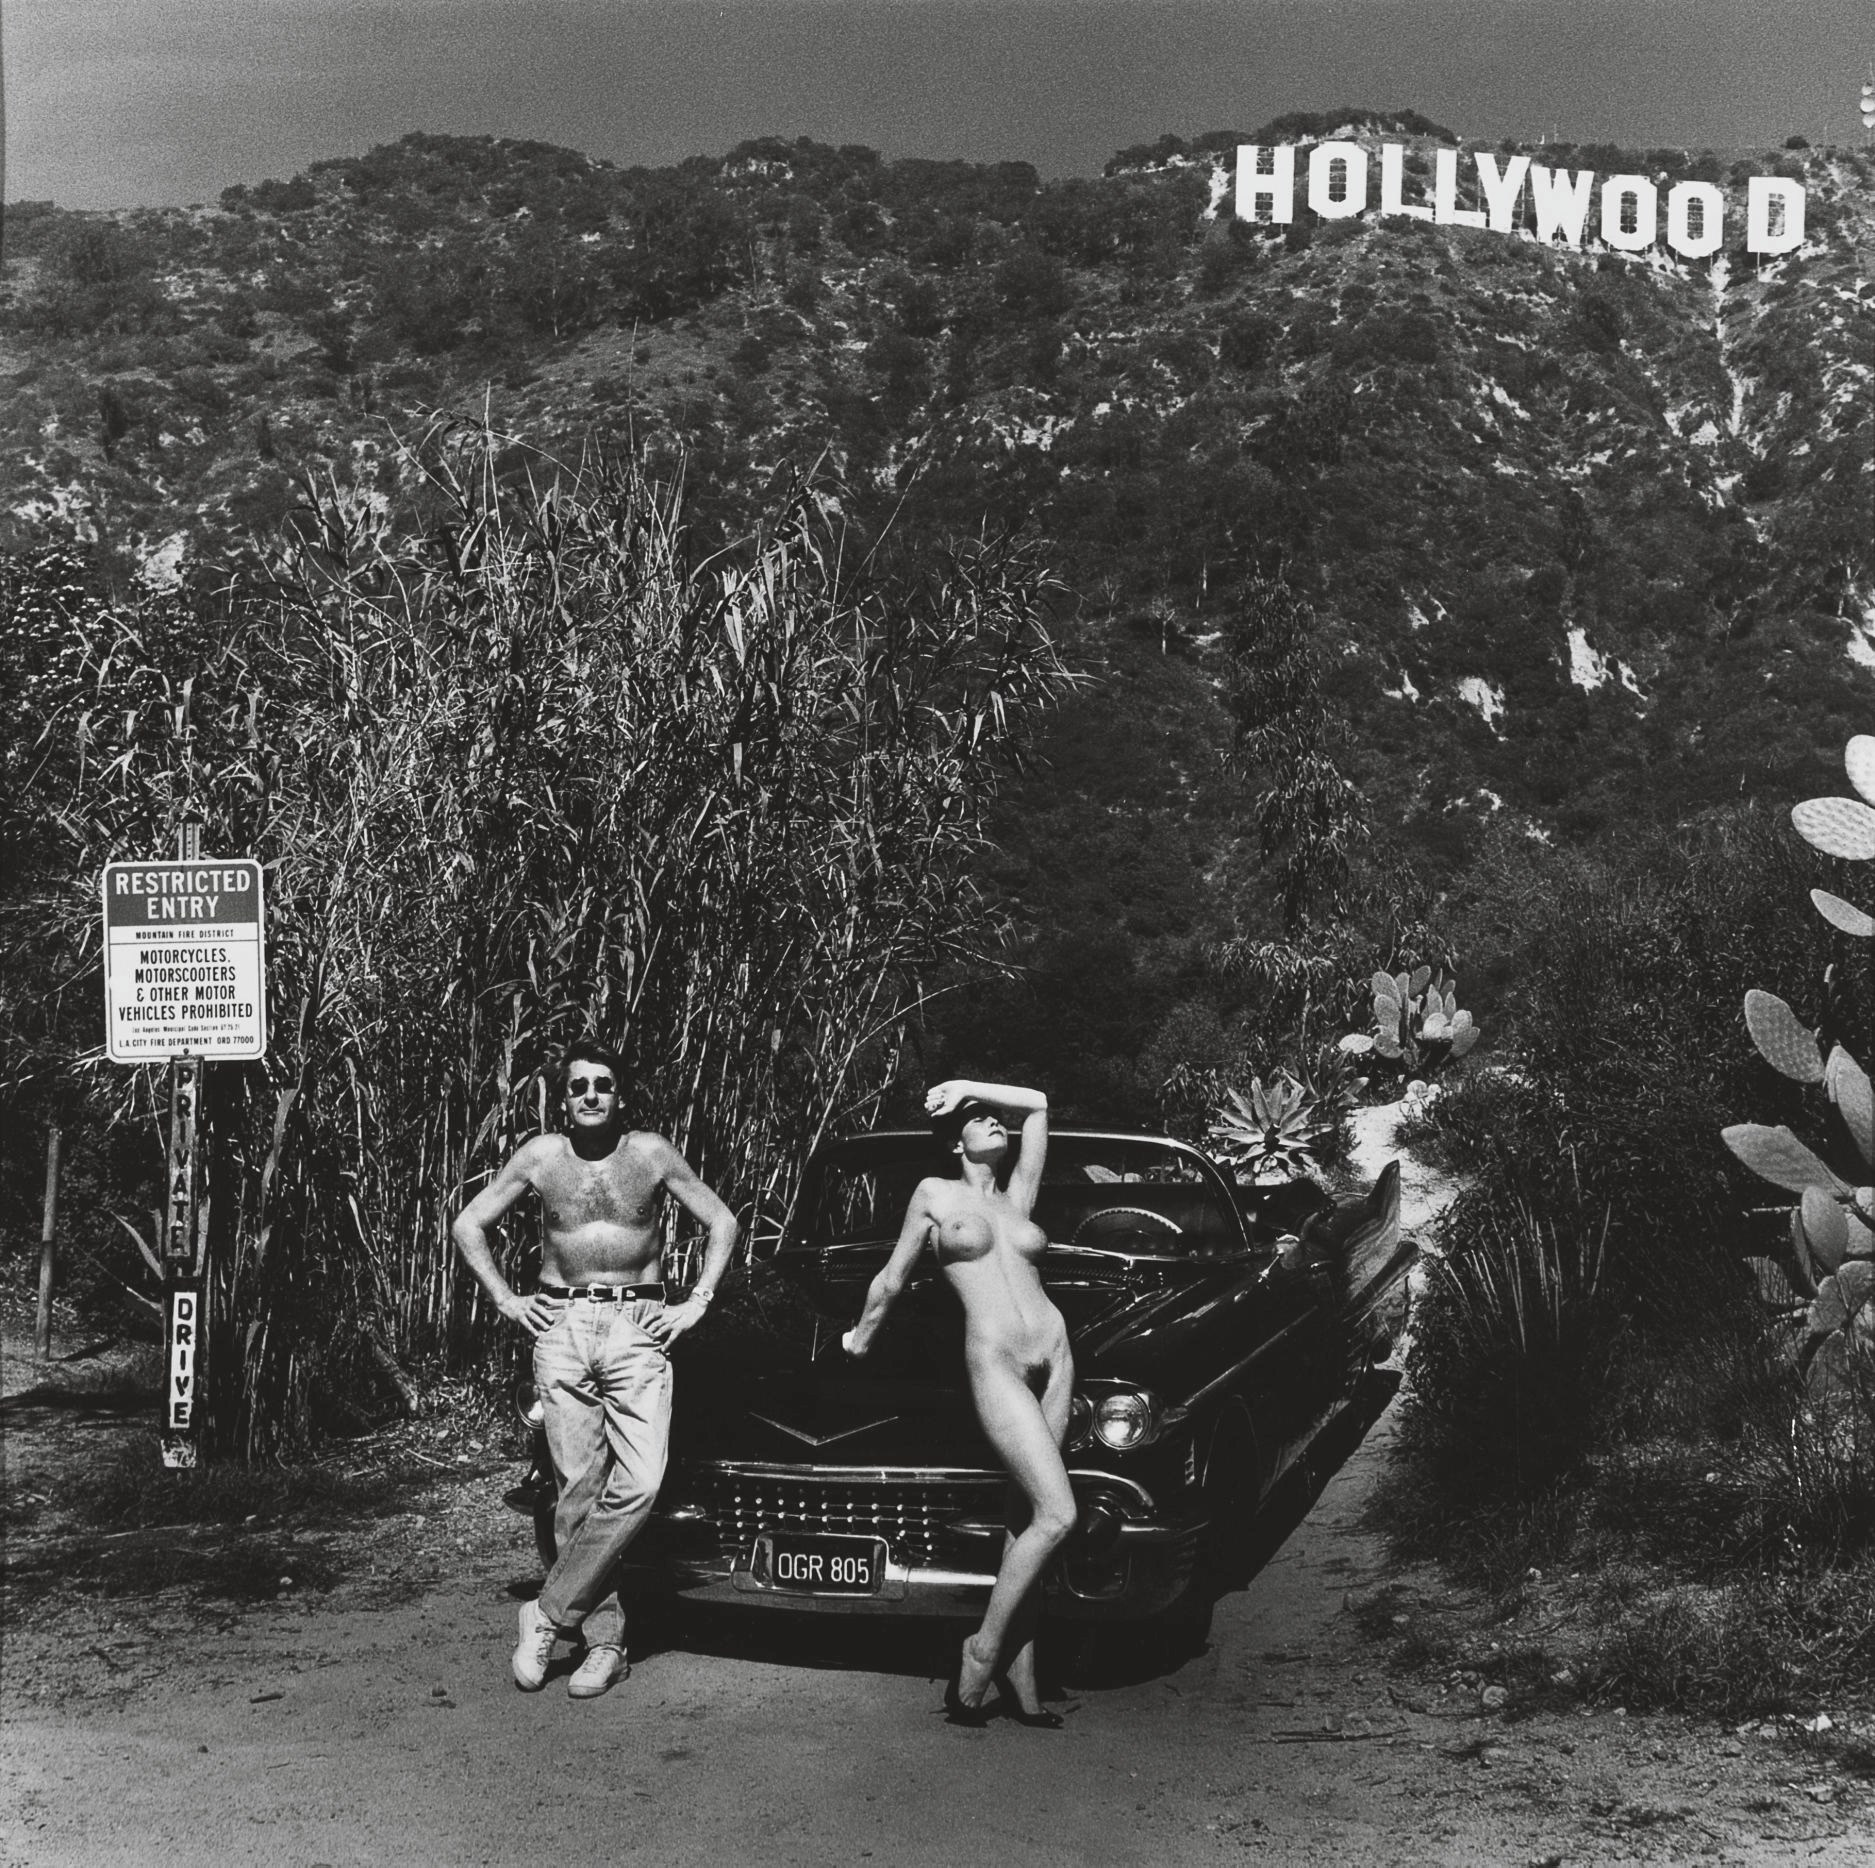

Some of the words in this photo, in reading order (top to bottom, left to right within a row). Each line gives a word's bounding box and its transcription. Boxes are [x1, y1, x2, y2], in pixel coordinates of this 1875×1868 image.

[1236, 142, 1805, 258] HOLLYWOOD
[115, 870, 250, 895] RESTRICTED
[147, 895, 219, 919] ENTRY
[135, 931, 174, 940] MOUNTAIN
[178, 931, 195, 939] FIRE
[200, 929, 234, 938] DISTRICT
[135, 966, 236, 983] MOTORSCOOTERS
[136, 988, 144, 1002] &
[150, 987, 189, 1002] OTHER
[195, 985, 236, 1000] MOTOR
[119, 1005, 176, 1021] VEHICLES
[181, 1003, 253, 1019] PROHIBITED
[132, 1039, 147, 1047] CITY
[150, 1038, 165, 1046] FIRE
[168, 1037, 212, 1045] DEPARTMENT
[233, 1036, 254, 1044] 77000
[171, 1066, 193, 1250] PRIVATE
[174, 1298, 193, 1424] DRIVE
[778, 1553, 823, 1581] OGR
[830, 1557, 869, 1584] 805
